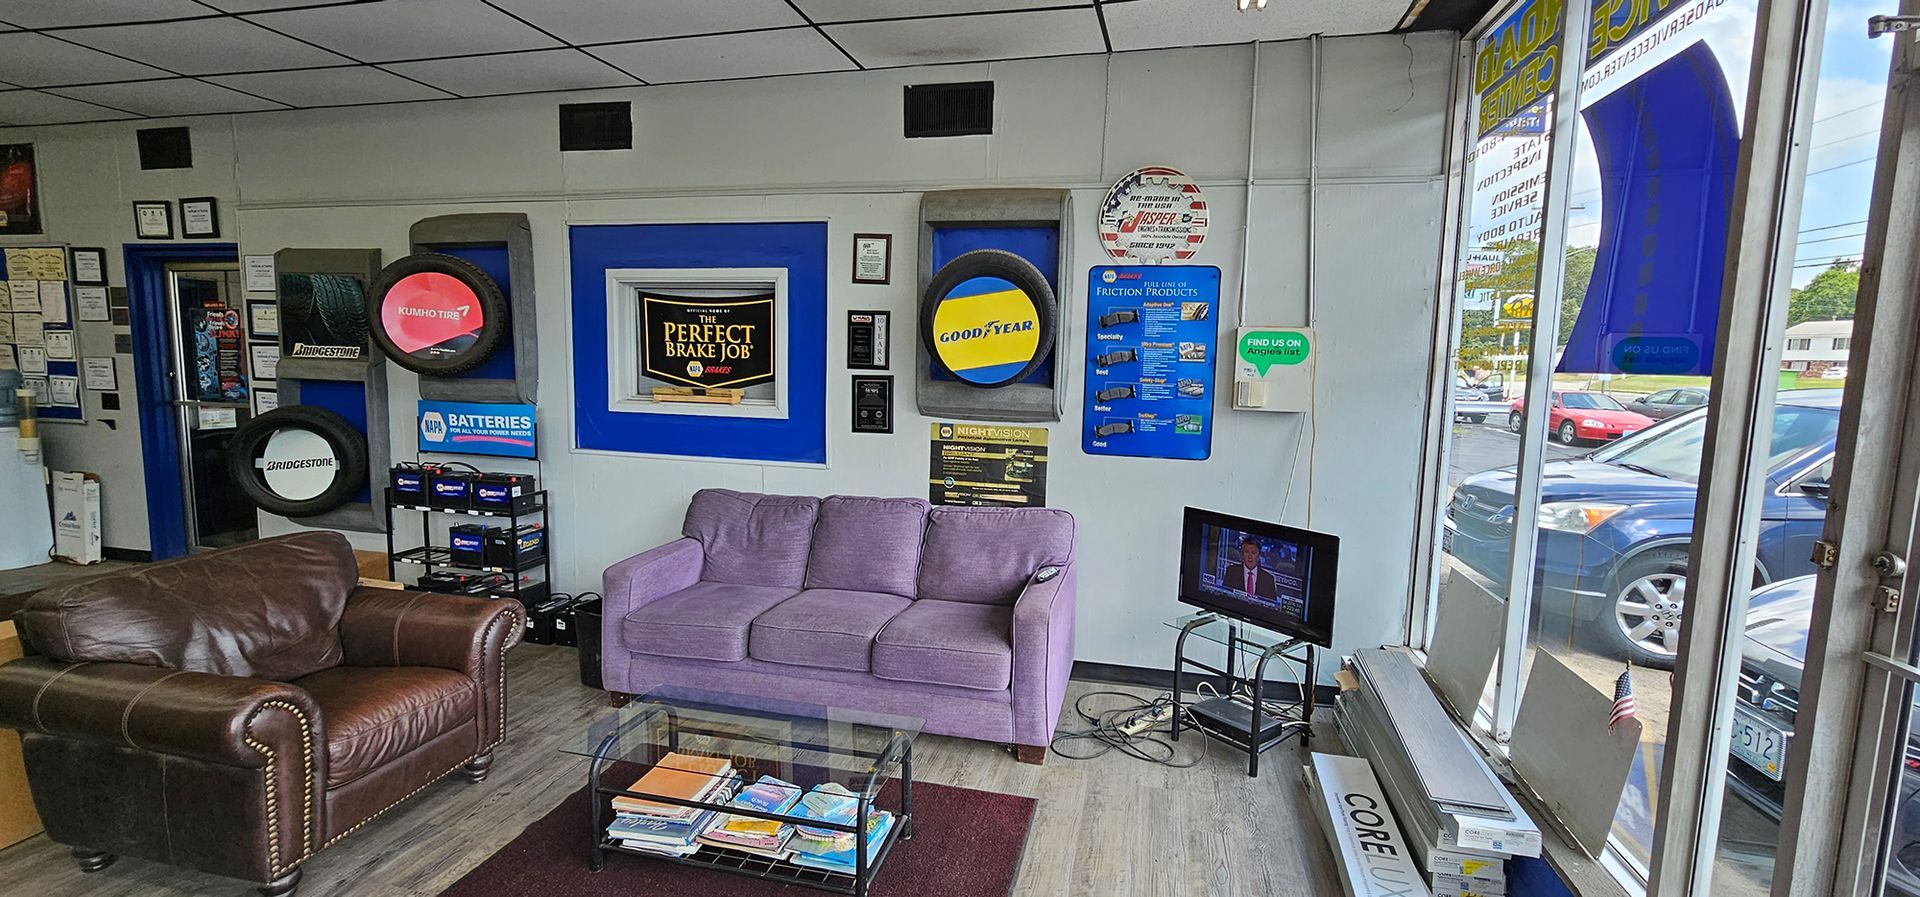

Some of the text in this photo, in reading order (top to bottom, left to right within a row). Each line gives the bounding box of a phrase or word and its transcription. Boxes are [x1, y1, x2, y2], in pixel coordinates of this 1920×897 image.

[1120, 210, 1177, 233] JASPER
[1096, 287, 1198, 297] FRICTION PRODUCTS
[398, 306, 460, 320] KUMHO TIRE
[699, 314, 717, 324] THE
[663, 321, 756, 344] PERFECT
[1097, 333, 1124, 341] Specialty
[1271, 339, 1285, 347] US
[1286, 339, 1302, 347] ON
[293, 343, 360, 358] BRIDGESTONE
[665, 341, 751, 363] BRAKE JOB
[1284, 348, 1300, 356] list
[704, 366, 732, 374] BRAKES
[424, 419, 443, 434] NAPA
[448, 413, 532, 429] BATTERIES
[957, 427, 1030, 438] NIGHTVISION
[266, 457, 333, 471] BRIDGESTONE
